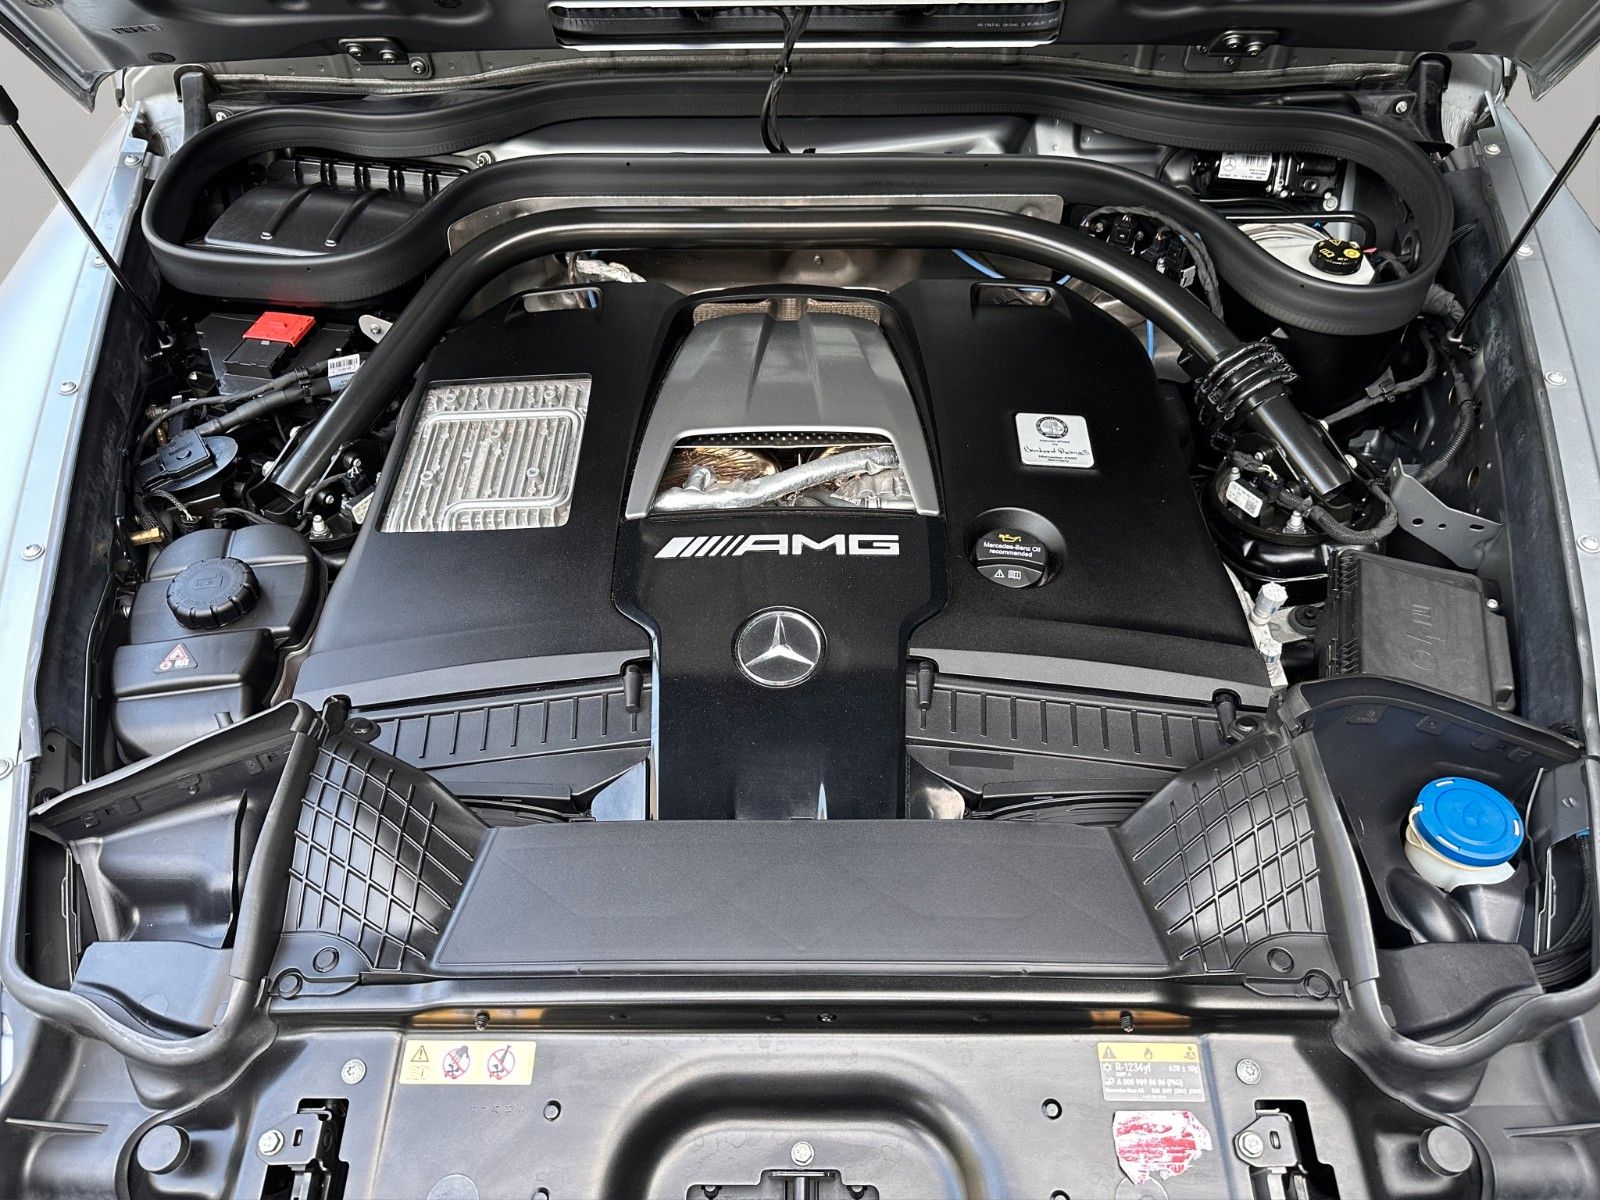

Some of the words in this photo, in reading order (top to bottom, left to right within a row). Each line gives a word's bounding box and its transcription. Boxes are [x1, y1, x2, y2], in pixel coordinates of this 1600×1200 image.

[732, 534, 900, 555] AMG
[983, 541, 1031, 551] Mercedes-Benz
[989, 549, 1033, 558] recommended
[1114, 1062, 1151, 1074] R-1234yf
